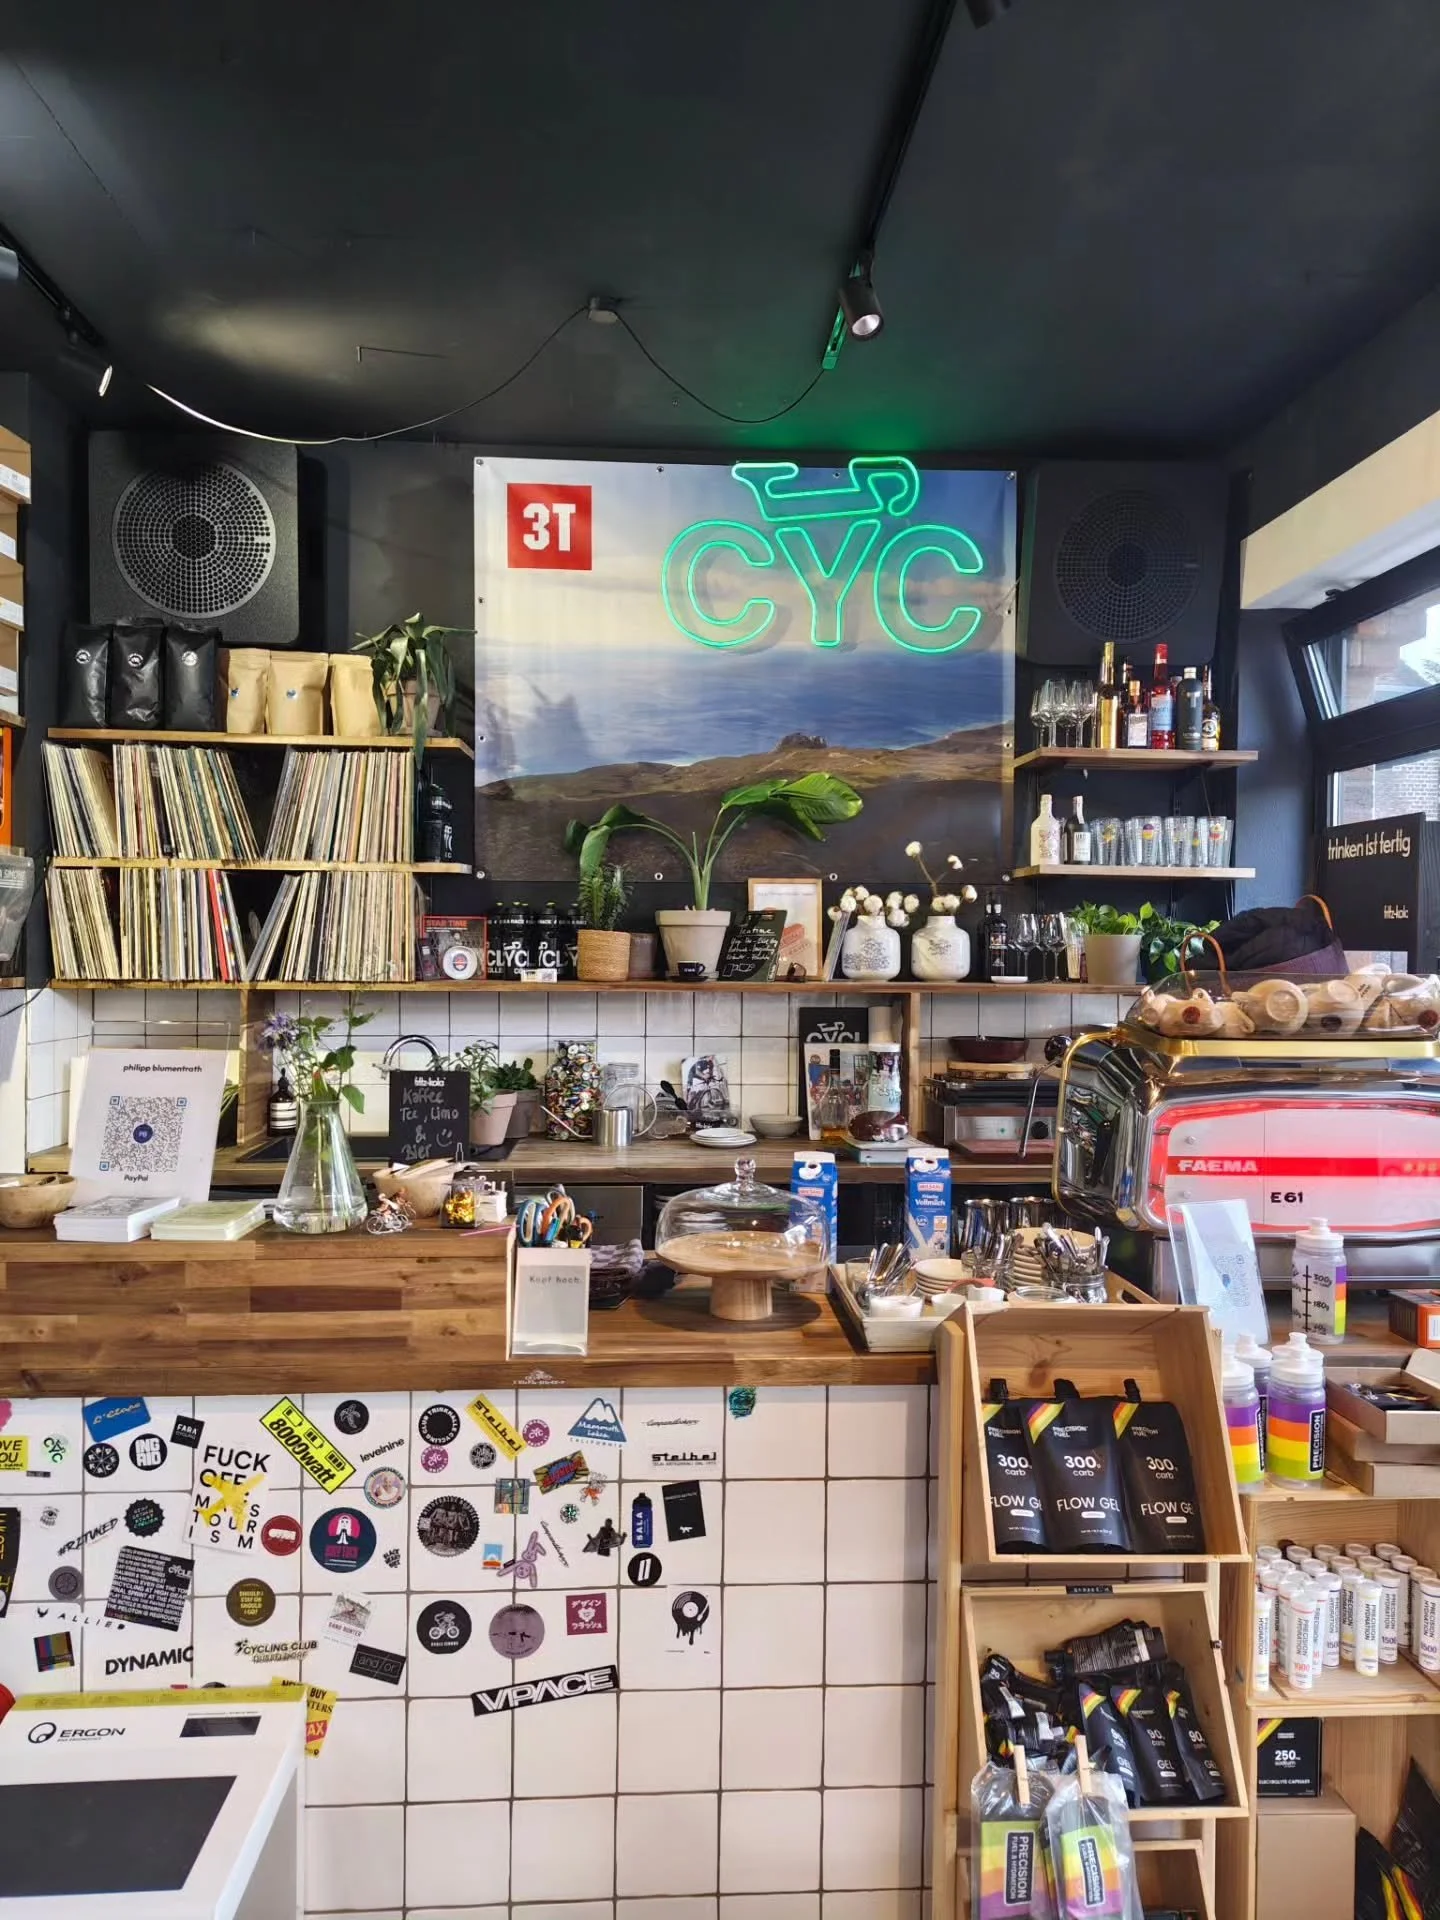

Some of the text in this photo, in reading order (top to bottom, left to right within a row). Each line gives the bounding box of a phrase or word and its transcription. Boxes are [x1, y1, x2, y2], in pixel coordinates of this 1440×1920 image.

[522, 502, 577, 552] 3T
[661, 519, 984, 653] CYC
[1328, 828, 1411, 860] trinken ist fertig
[448, 919, 468, 927] TIME
[123, 1063, 151, 1074] philipp
[402, 1087, 444, 1105] Kaffee
[431, 1106, 459, 1120] Limo
[1178, 1160, 1258, 1173] FAEMA
[124, 1174, 149, 1183] PayPal
[915, 1198, 946, 1207] Vollmilch
[177, 1424, 197, 1435] FARA
[1312, 1415, 1321, 1468] PRECISION
[360, 1437, 405, 1463] levelnine
[203, 1444, 271, 1473] FUCK
[1072, 1469, 1094, 1477] carb
[1155, 1471, 1174, 1480] carb
[1056, 1497, 1120, 1513] FLOW GEL
[1141, 1501, 1177, 1516] FLOW
[242, 1640, 318, 1656] CYCLING CLUB
[105, 1646, 194, 1676] DYNAMIC
[310, 1687, 327, 1700] BUY
[476, 1668, 614, 1712] VPACE
[59, 1727, 126, 1738] ERGON
[1157, 1759, 1175, 1770] GEL
[1016, 1836, 1029, 1899] PRECISION
[1086, 1842, 1101, 1901] PRECISION
